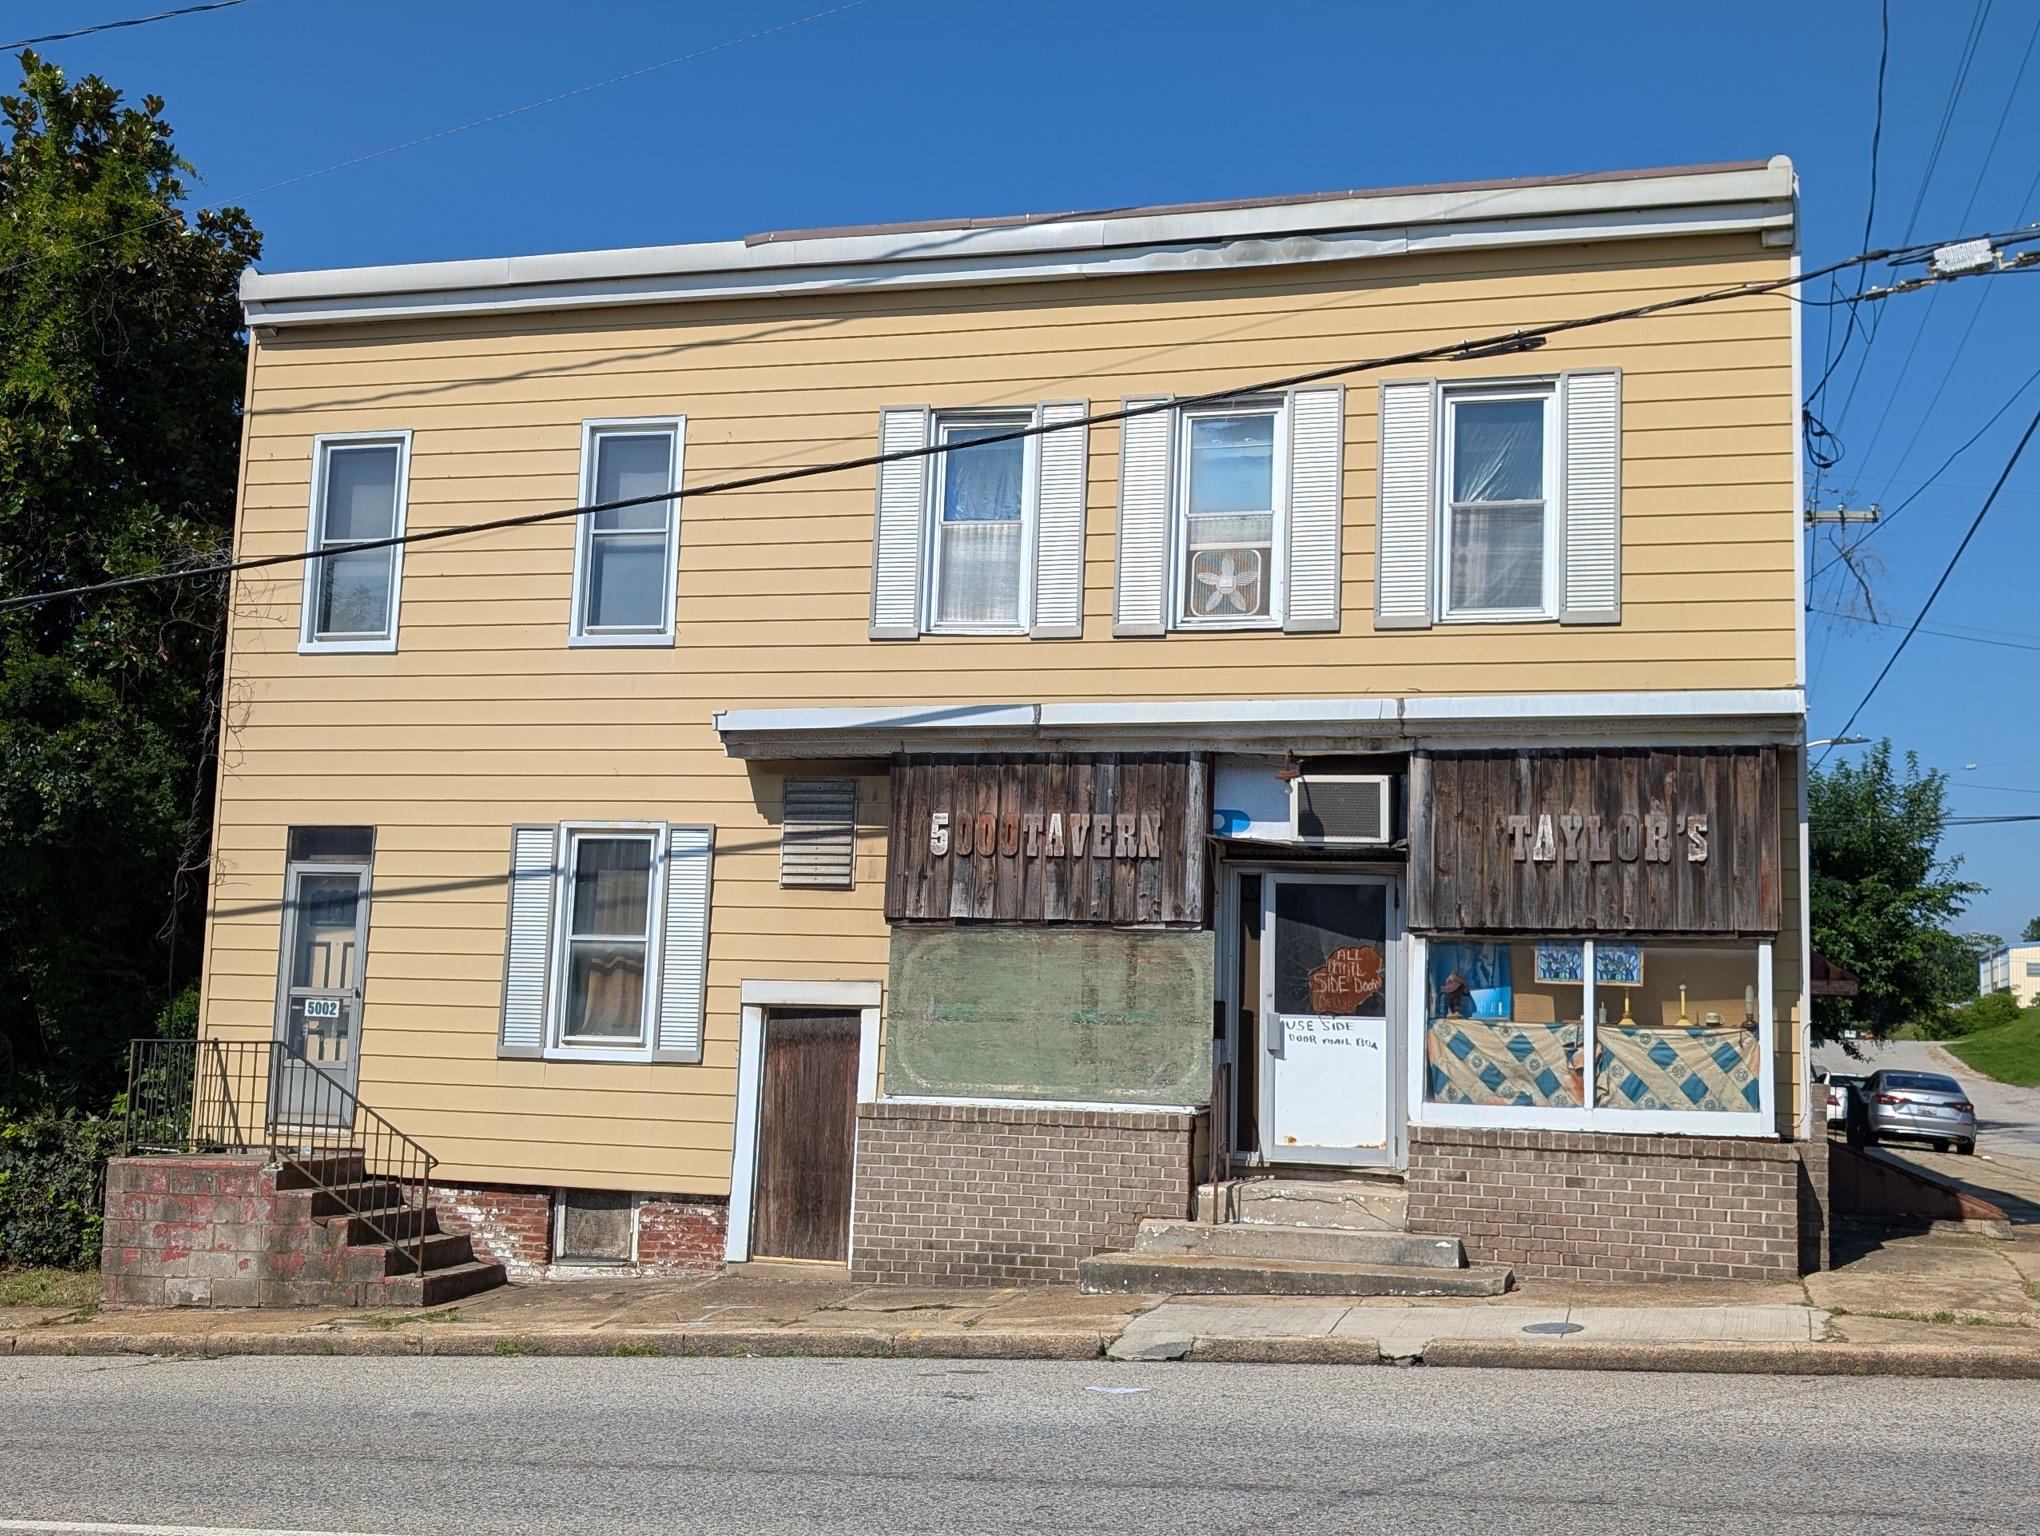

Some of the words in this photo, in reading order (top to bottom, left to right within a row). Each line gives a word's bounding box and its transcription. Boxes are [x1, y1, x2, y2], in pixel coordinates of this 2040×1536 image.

[1508, 813, 1708, 862] TAYLOR'S
[1336, 948, 1363, 961] ALL
[307, 1001, 337, 1016] 5002
[1285, 1020, 1314, 1031] USE
[1321, 1020, 1356, 1031] SIDE
[1288, 1033, 1317, 1045] DOOR
